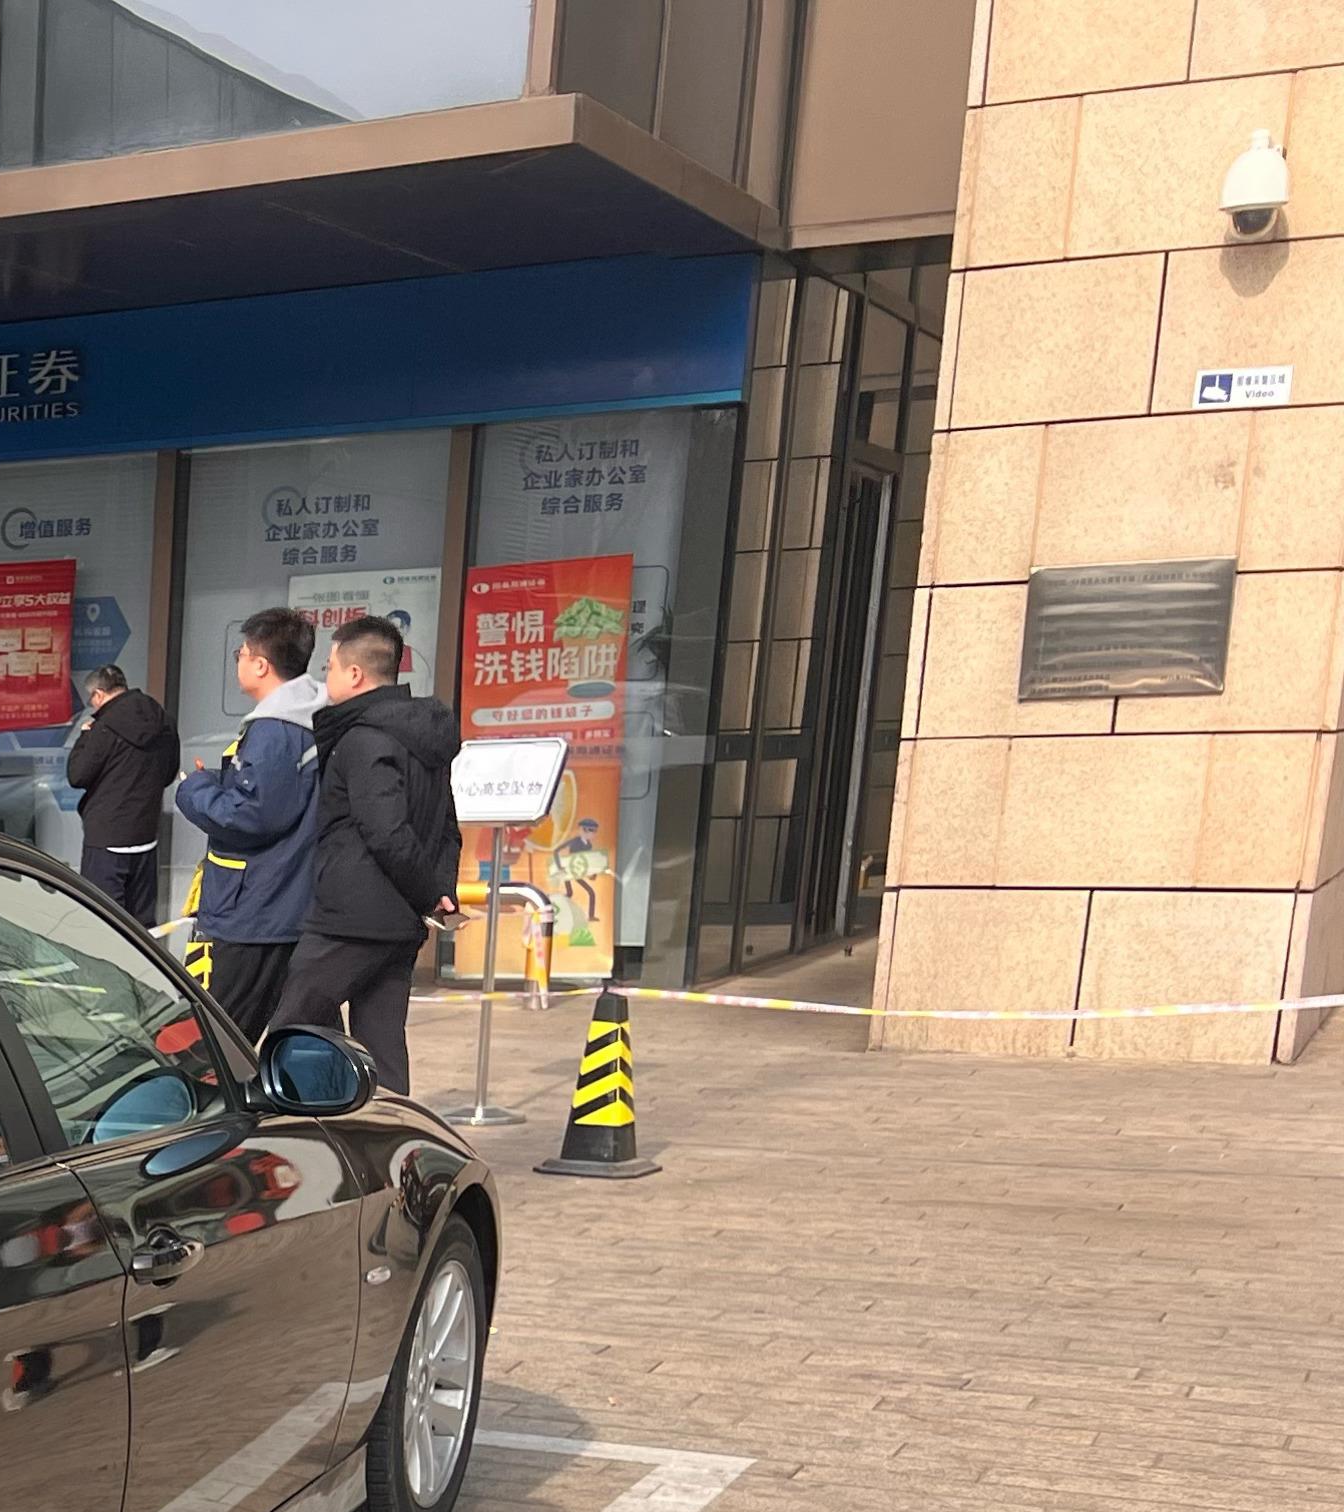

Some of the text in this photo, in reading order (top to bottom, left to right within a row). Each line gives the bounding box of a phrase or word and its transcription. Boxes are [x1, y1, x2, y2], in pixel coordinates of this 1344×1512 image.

[535, 439, 640, 464] 私人订制和
[522, 464, 648, 491] 企业家办公室
[276, 494, 371, 517] 私人订制和
[540, 493, 625, 516] 综合服务
[18, 517, 92, 540] 增值服务
[264, 519, 380, 543] 企业家办公室
[282, 545, 358, 566] 综合服务
[475, 610, 545, 647] 警惕
[474, 643, 619, 688] 洗钱陷阱
